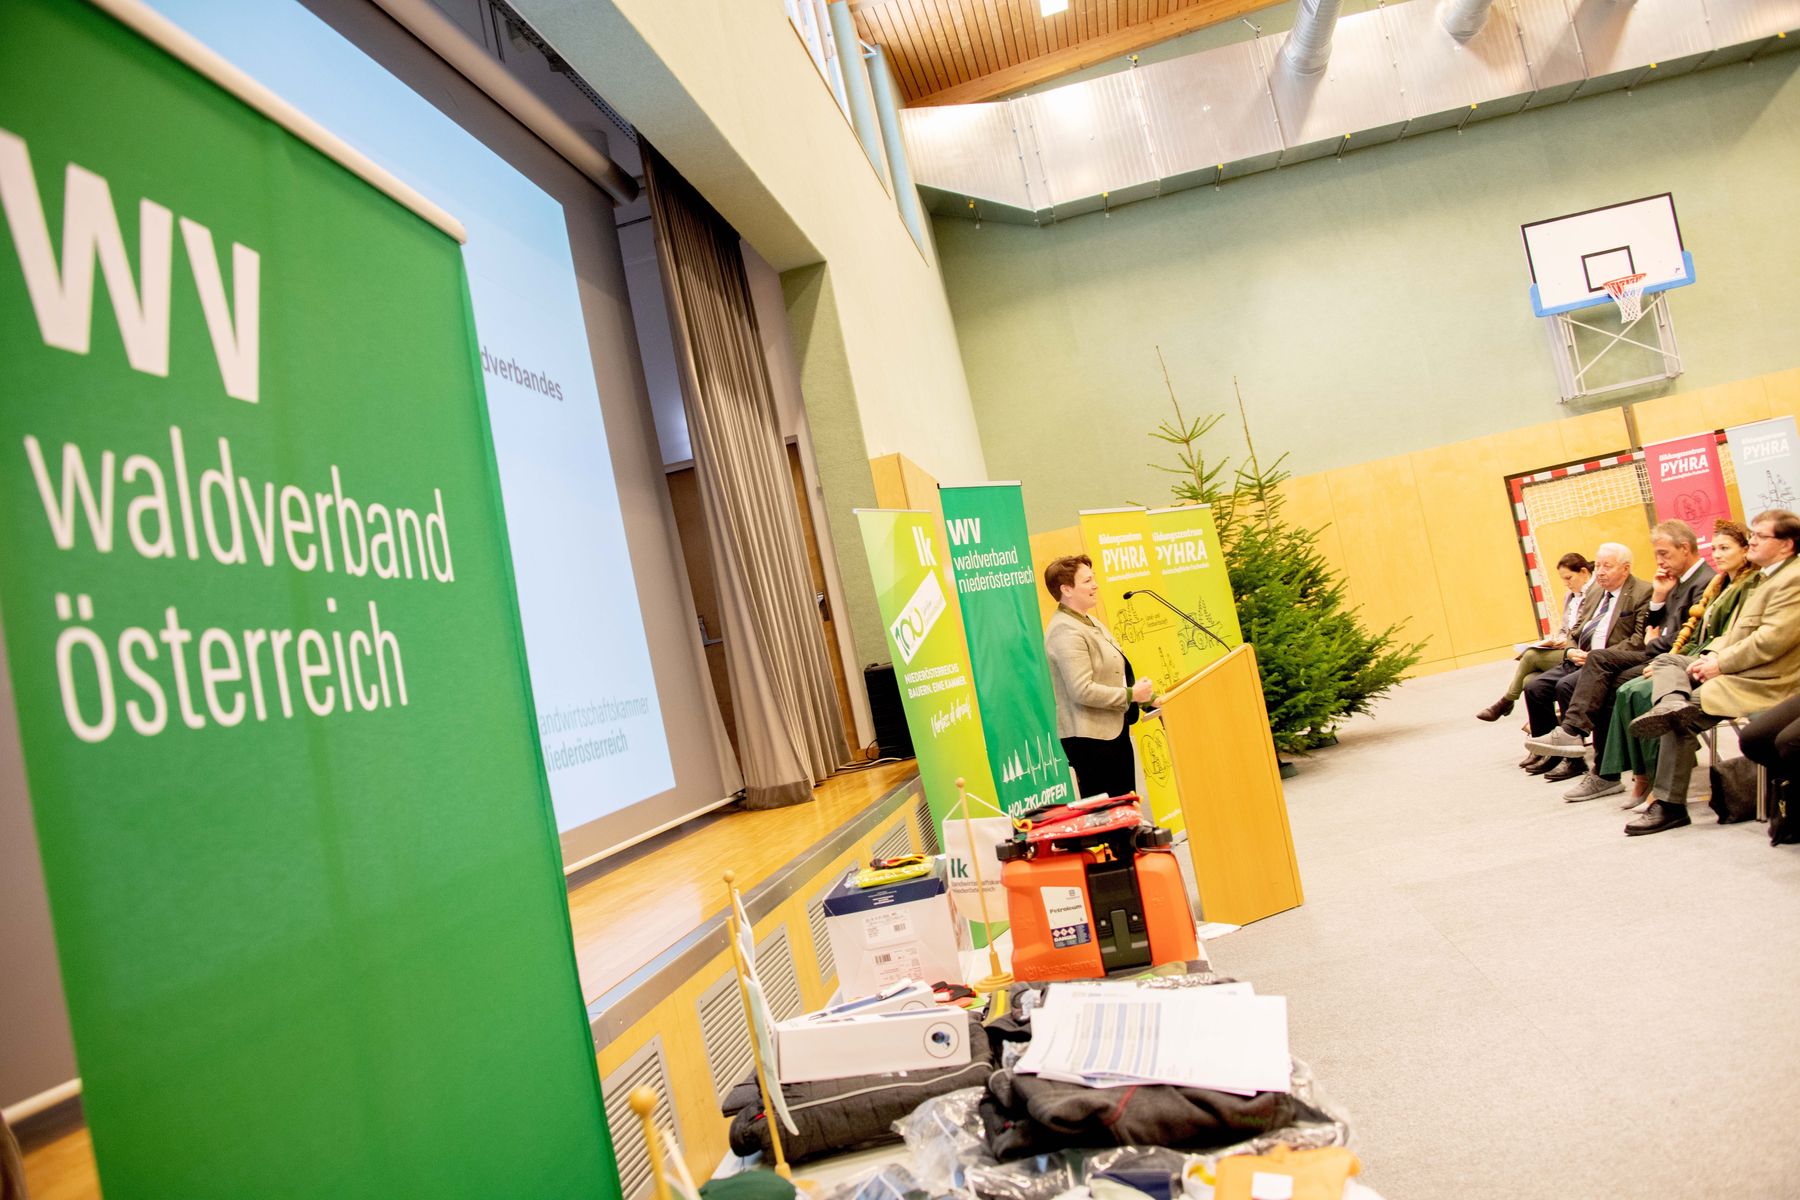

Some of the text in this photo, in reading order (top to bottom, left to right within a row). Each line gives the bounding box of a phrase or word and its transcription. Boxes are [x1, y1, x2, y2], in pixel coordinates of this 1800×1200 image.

[1743, 438, 1790, 460] PYHRA
[1660, 454, 1709, 477] PYHRA
[24, 425, 455, 582] waldverband
[954, 546, 1018, 571] waldverband
[1102, 545, 1149, 573] PYHRA
[958, 565, 1035, 594] niederösterreich
[55, 592, 408, 743] österreich
[1008, 782, 1067, 819] HOLZKLOPFEN
